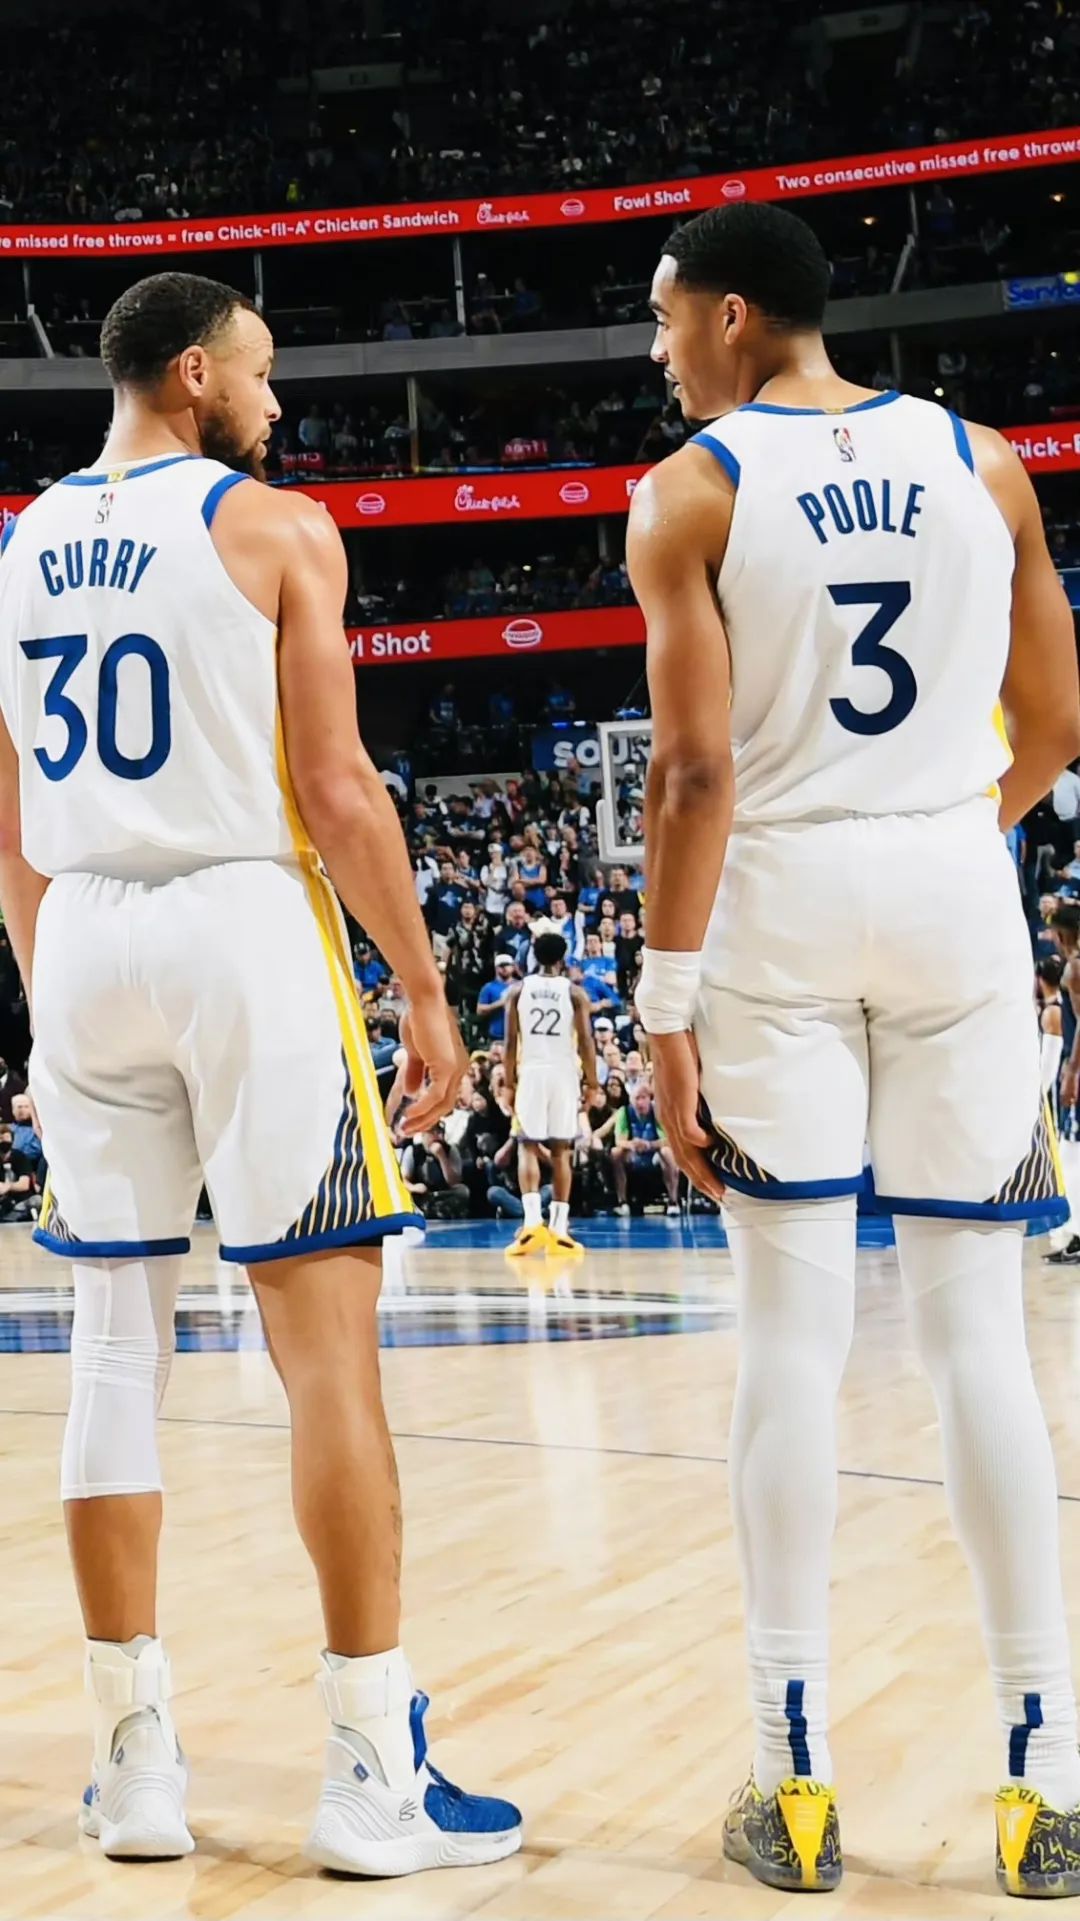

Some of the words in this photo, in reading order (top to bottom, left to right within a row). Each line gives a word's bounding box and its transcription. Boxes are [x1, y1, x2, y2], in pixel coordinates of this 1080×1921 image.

[776, 172, 811, 190] Two
[814, 158, 916, 185] consecutive
[920, 150, 979, 172] missed
[984, 147, 1020, 164] free
[613, 193, 650, 212] Fowl
[654, 188, 691, 207] Shot
[15, 234, 68, 249] missed
[72, 234, 105, 248] free
[109, 233, 163, 247] throws
[181, 229, 214, 243] free
[314, 216, 378, 234] Chicken
[383, 211, 459, 230] Sandwich
[796, 478, 926, 545] POOLE
[38, 537, 157, 597] CURRY
[372, 630, 432, 657] Shot
[826, 580, 918, 736] 3
[18, 632, 172, 782] 30
[529, 1007, 561, 1036] 22
